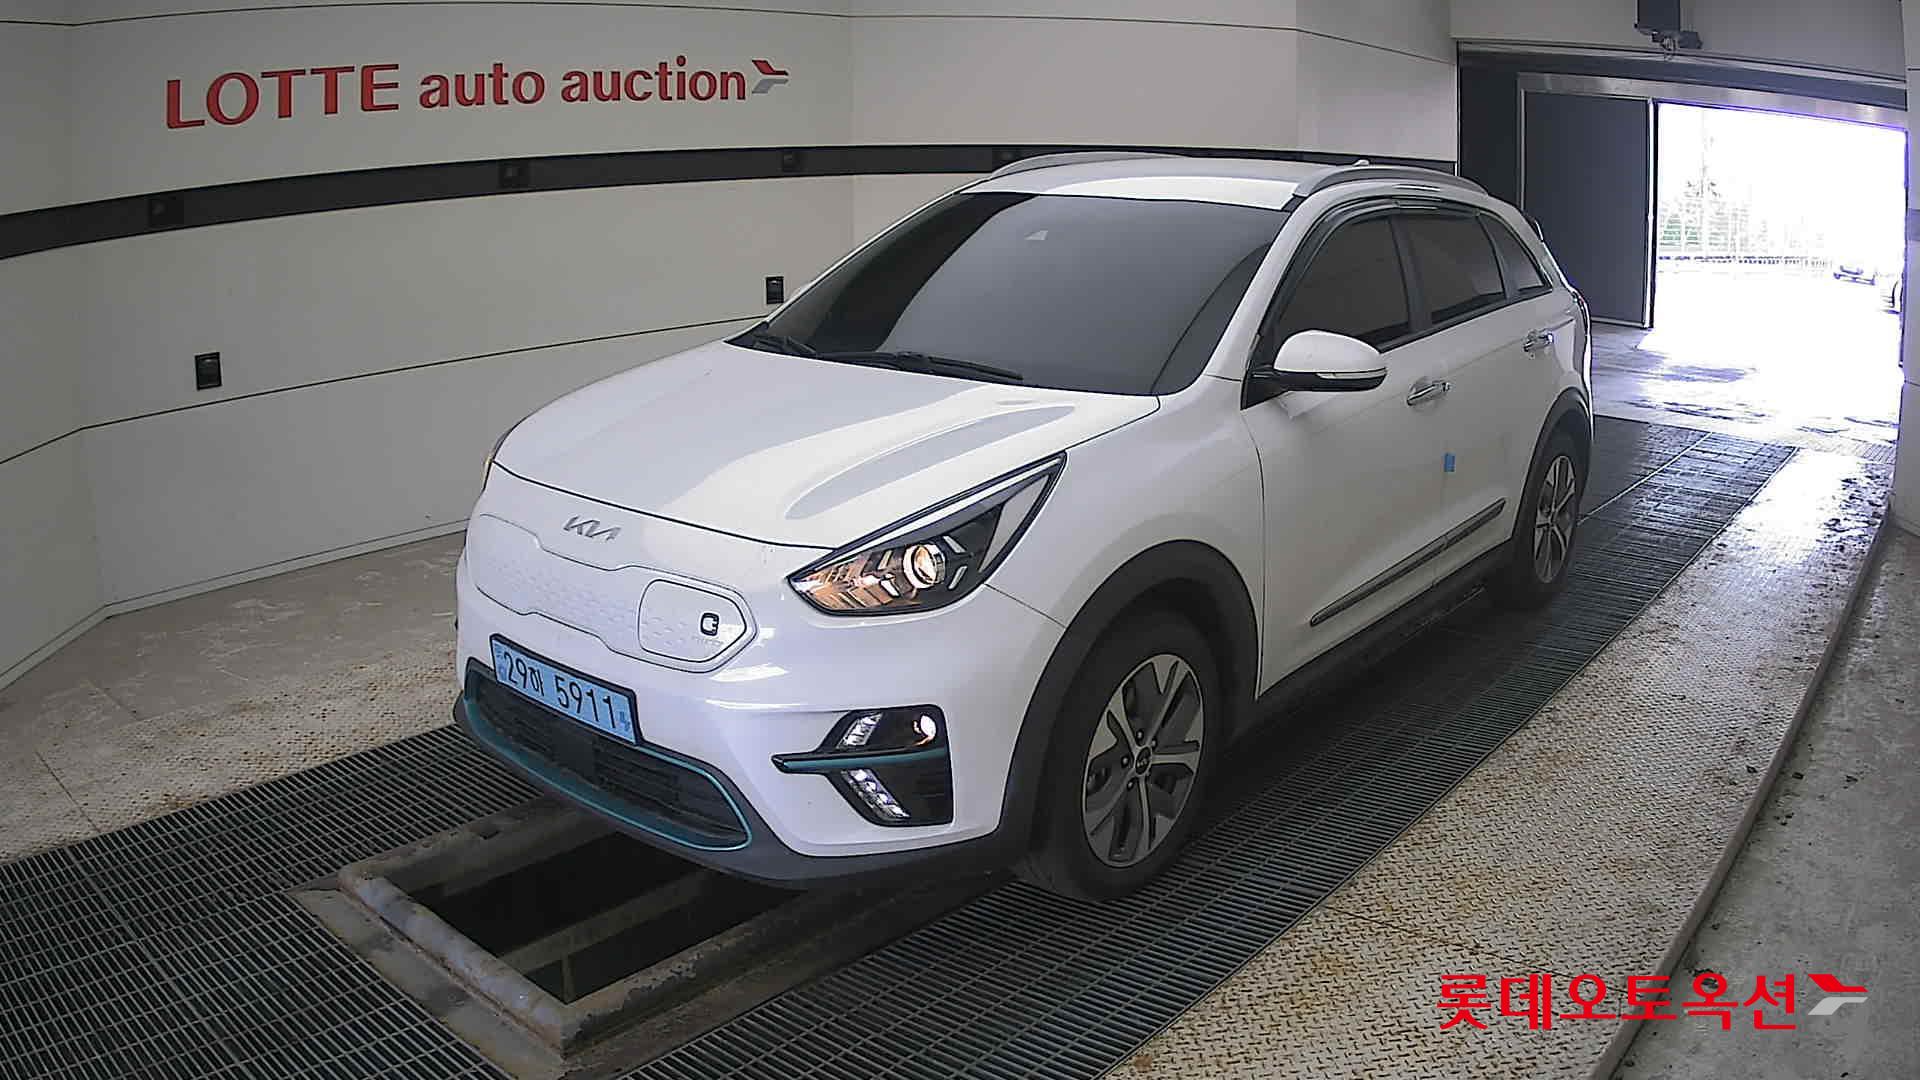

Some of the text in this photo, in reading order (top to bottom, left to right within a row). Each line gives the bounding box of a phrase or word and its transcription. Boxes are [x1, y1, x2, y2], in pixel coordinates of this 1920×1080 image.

[166, 56, 746, 128] LOTTE auto auction
[554, 674, 616, 729] 5911
